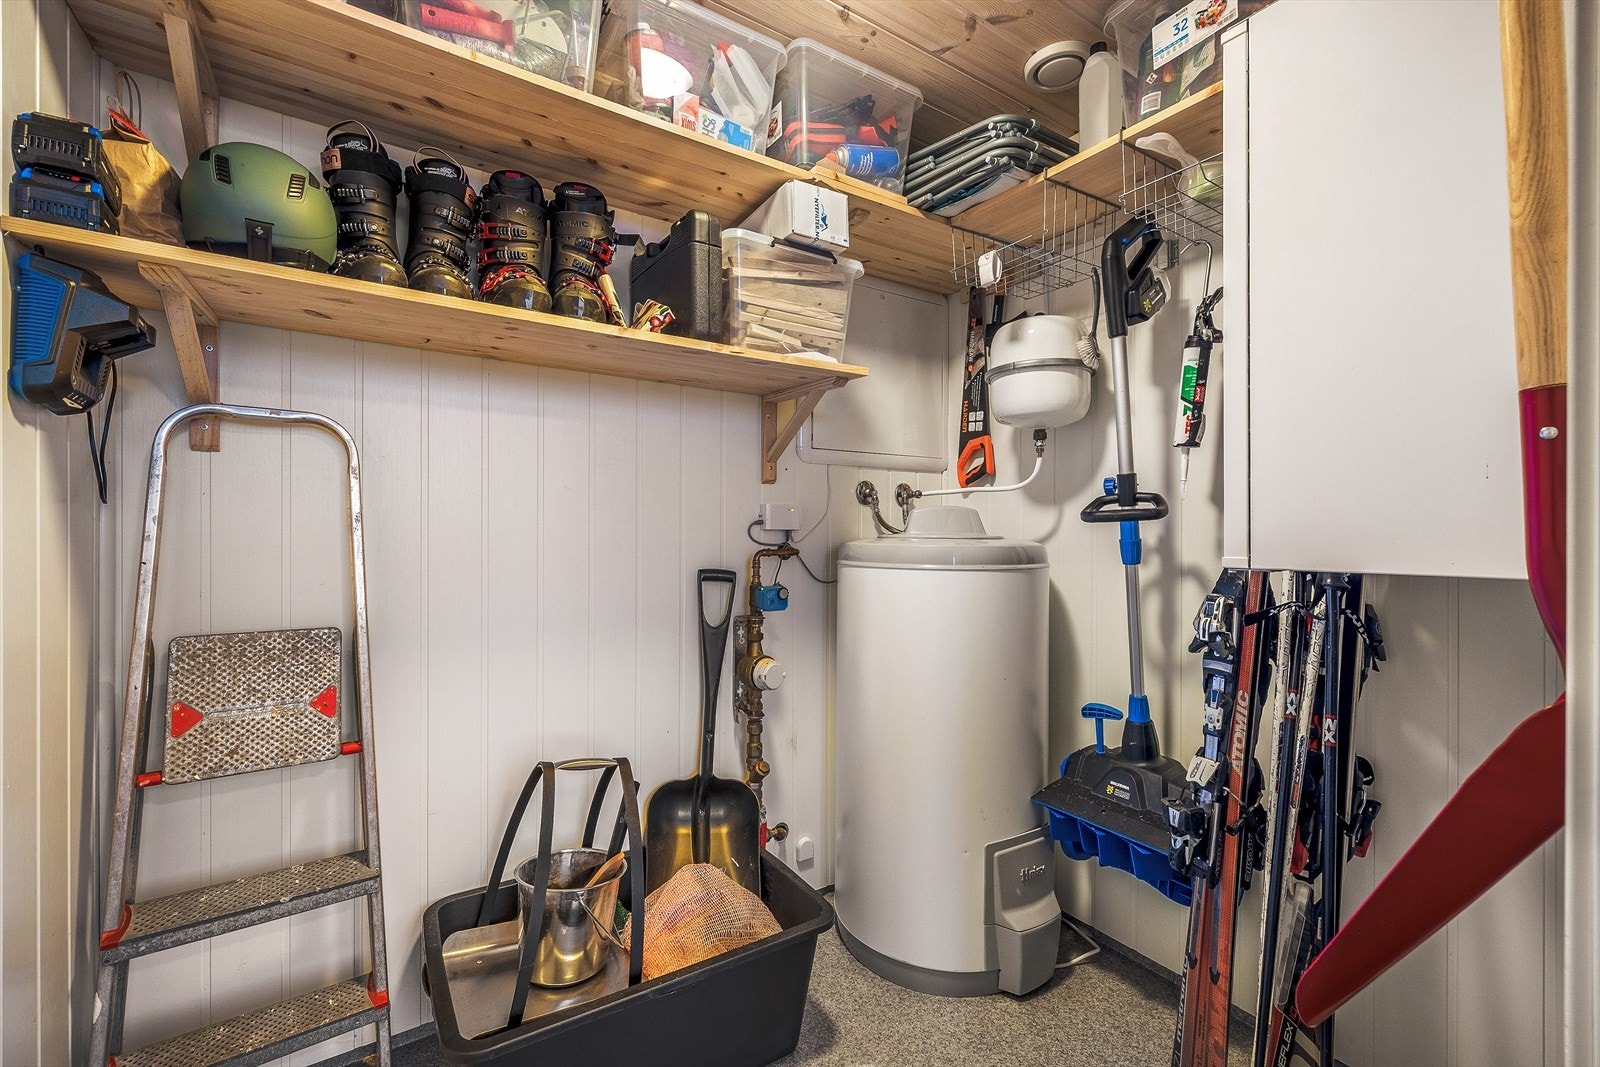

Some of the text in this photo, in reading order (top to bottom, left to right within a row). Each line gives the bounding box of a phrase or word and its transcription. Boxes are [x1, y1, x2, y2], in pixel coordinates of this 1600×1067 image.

[1173, 17, 1189, 37] 32
[961, 400, 969, 433] HARDEN
[1231, 690, 1249, 776] ATOMIC
[1277, 1021, 1294, 1067] EFLEX
